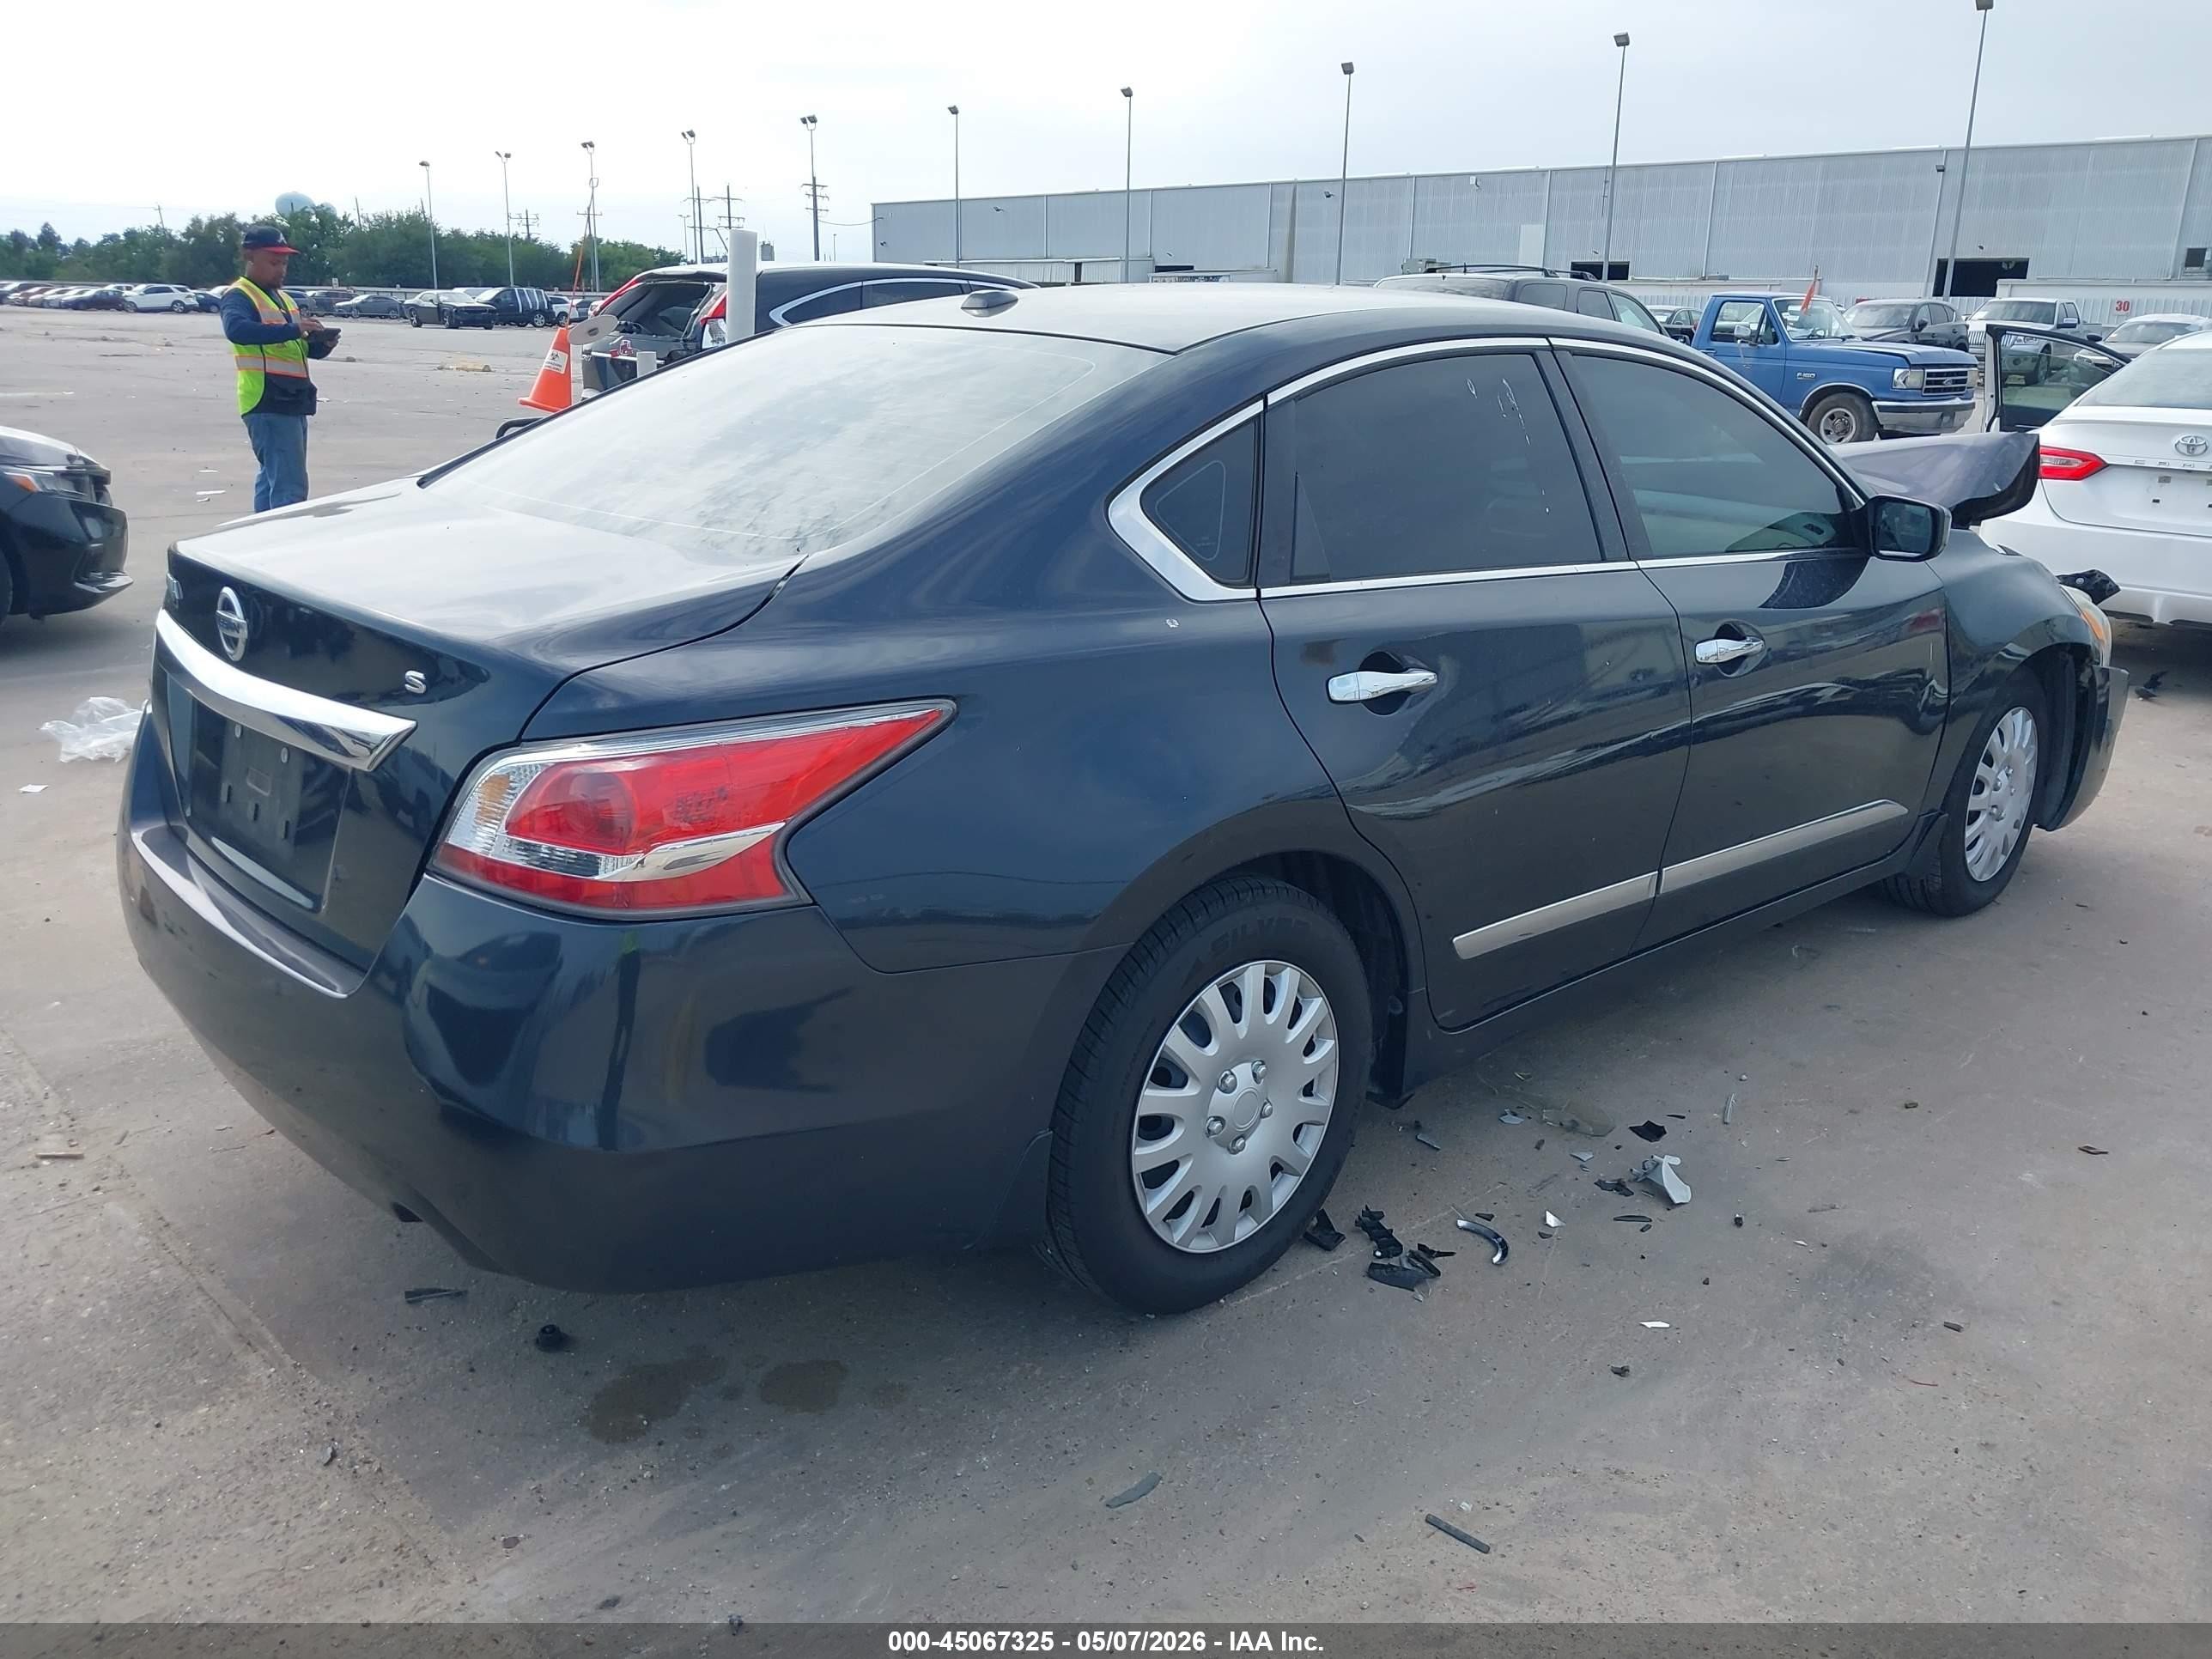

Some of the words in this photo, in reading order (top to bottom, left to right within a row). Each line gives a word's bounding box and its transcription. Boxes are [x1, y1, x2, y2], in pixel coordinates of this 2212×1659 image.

[2115, 301, 2130, 312] 30
[2132, 459, 2212, 470] CAM
[404, 670, 427, 694] S
